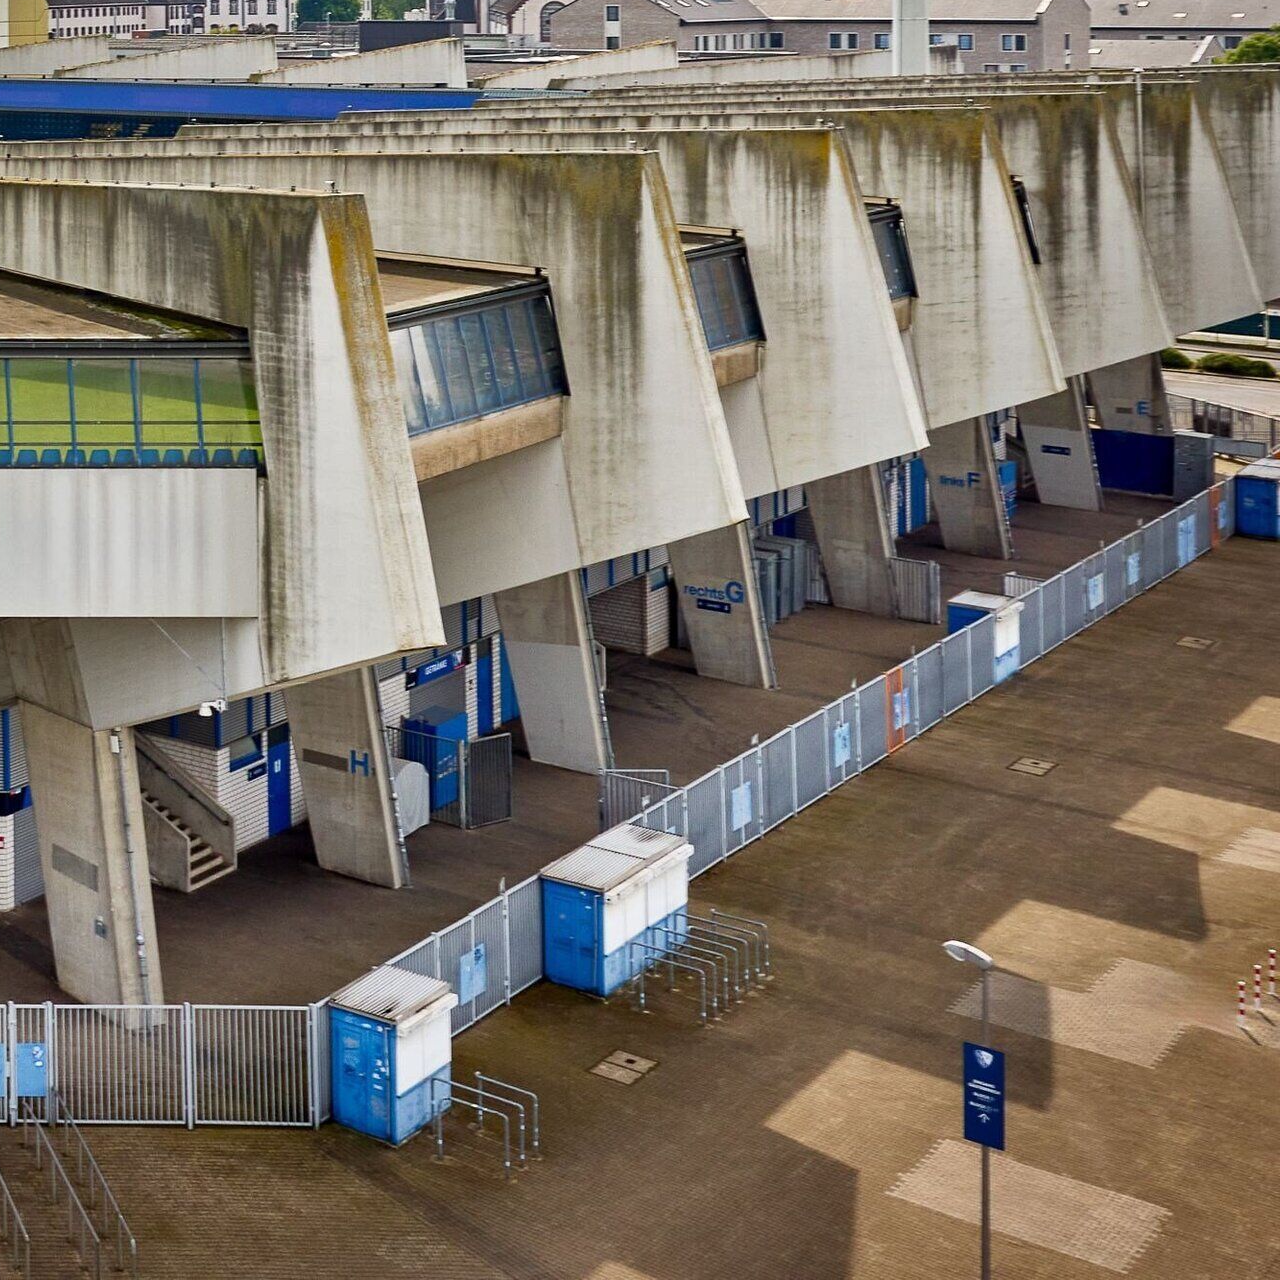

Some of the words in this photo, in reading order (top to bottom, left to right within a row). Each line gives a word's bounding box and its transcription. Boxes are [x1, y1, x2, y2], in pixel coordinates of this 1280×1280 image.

[1136, 401, 1151, 415] E
[967, 472, 981, 487] F
[683, 585, 726, 600] rechts
[725, 581, 744, 604] G
[349, 749, 370, 776] H
